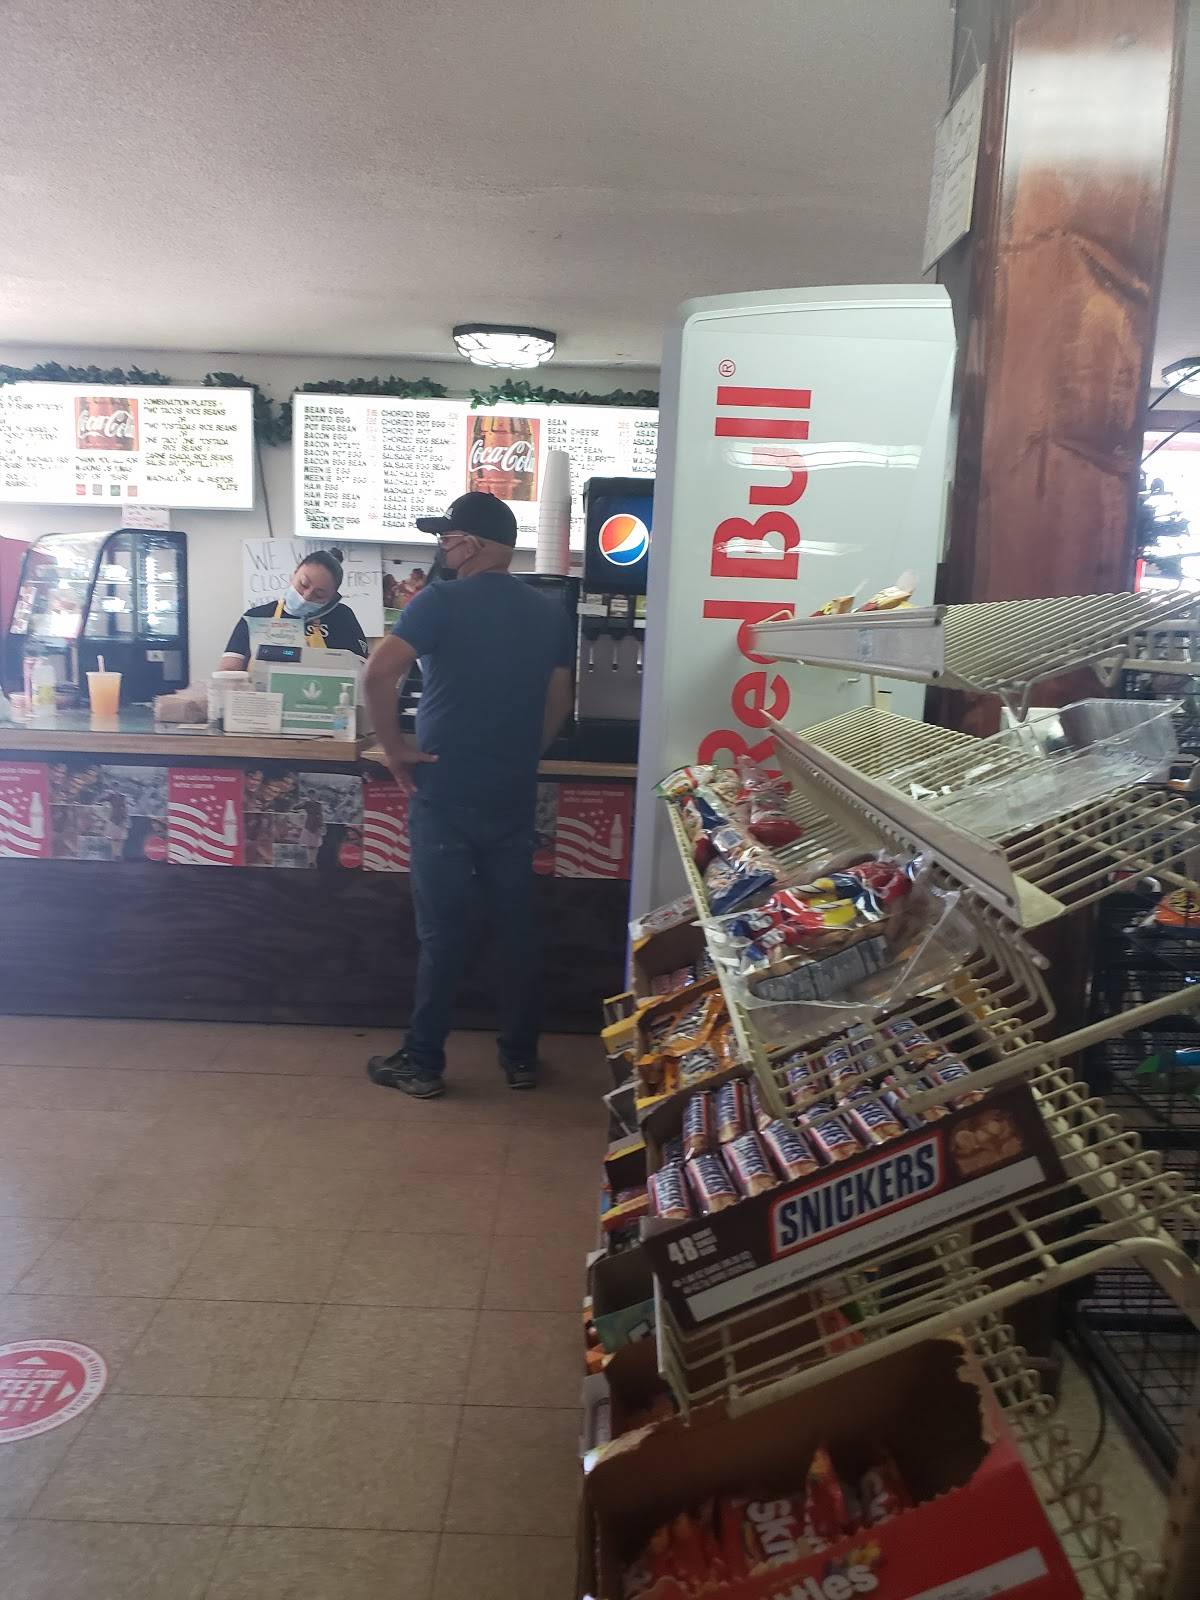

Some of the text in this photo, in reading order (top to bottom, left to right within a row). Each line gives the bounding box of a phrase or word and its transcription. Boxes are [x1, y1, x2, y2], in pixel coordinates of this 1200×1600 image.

[304, 406, 325, 414] BEAN
[304, 449, 329, 457] BACON
[710, 386, 812, 580] Bull
[250, 573, 289, 592] CLOS
[779, 1142, 936, 1248] SNICKERS
[668, 1236, 699, 1265] 48
